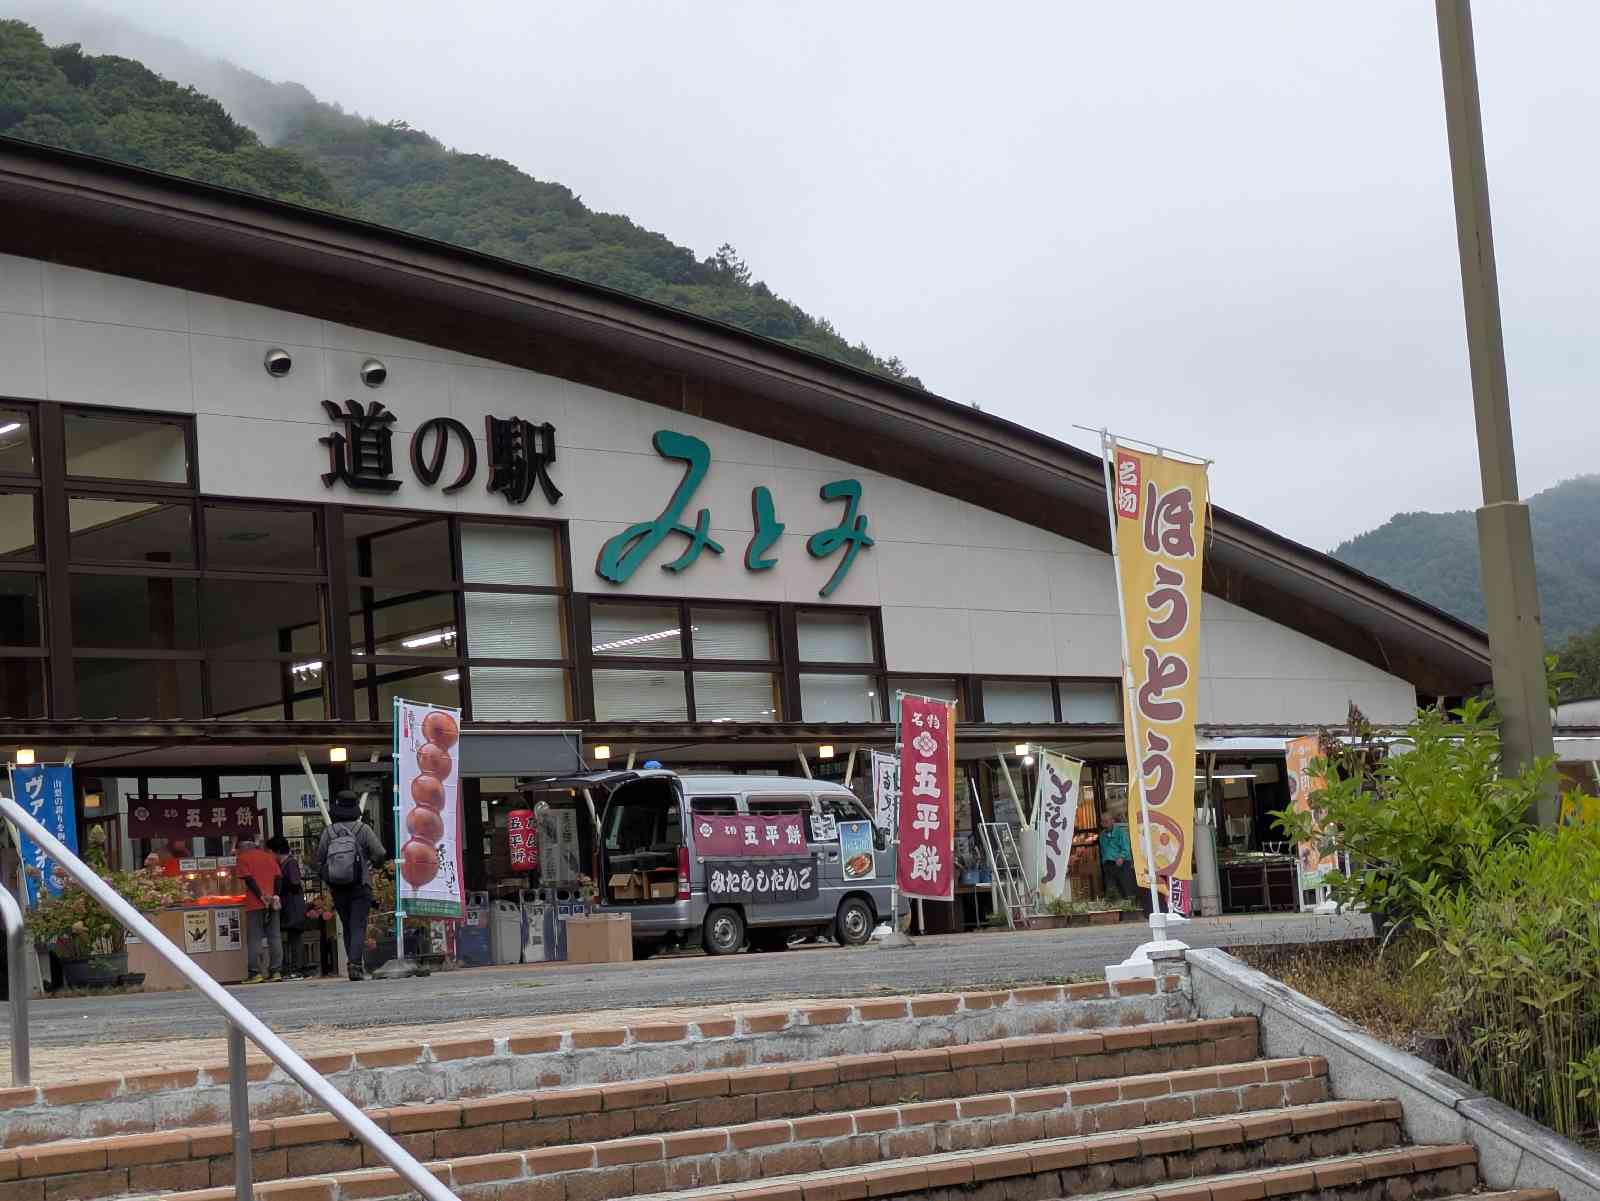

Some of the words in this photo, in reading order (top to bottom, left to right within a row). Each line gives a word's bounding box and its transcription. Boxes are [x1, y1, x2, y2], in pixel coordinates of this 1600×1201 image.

[319, 400, 563, 505] 道の駅
[595, 429, 874, 597] みとみ
[1119, 460, 1137, 513] 名物
[1138, 480, 1196, 805] ほうとう
[911, 711, 940, 729] 名物
[185, 807, 255, 828] 五平餅
[744, 824, 802, 847] 五平餅
[909, 762, 942, 883] 五平餅
[710, 866, 812, 893] みたらしだんご
